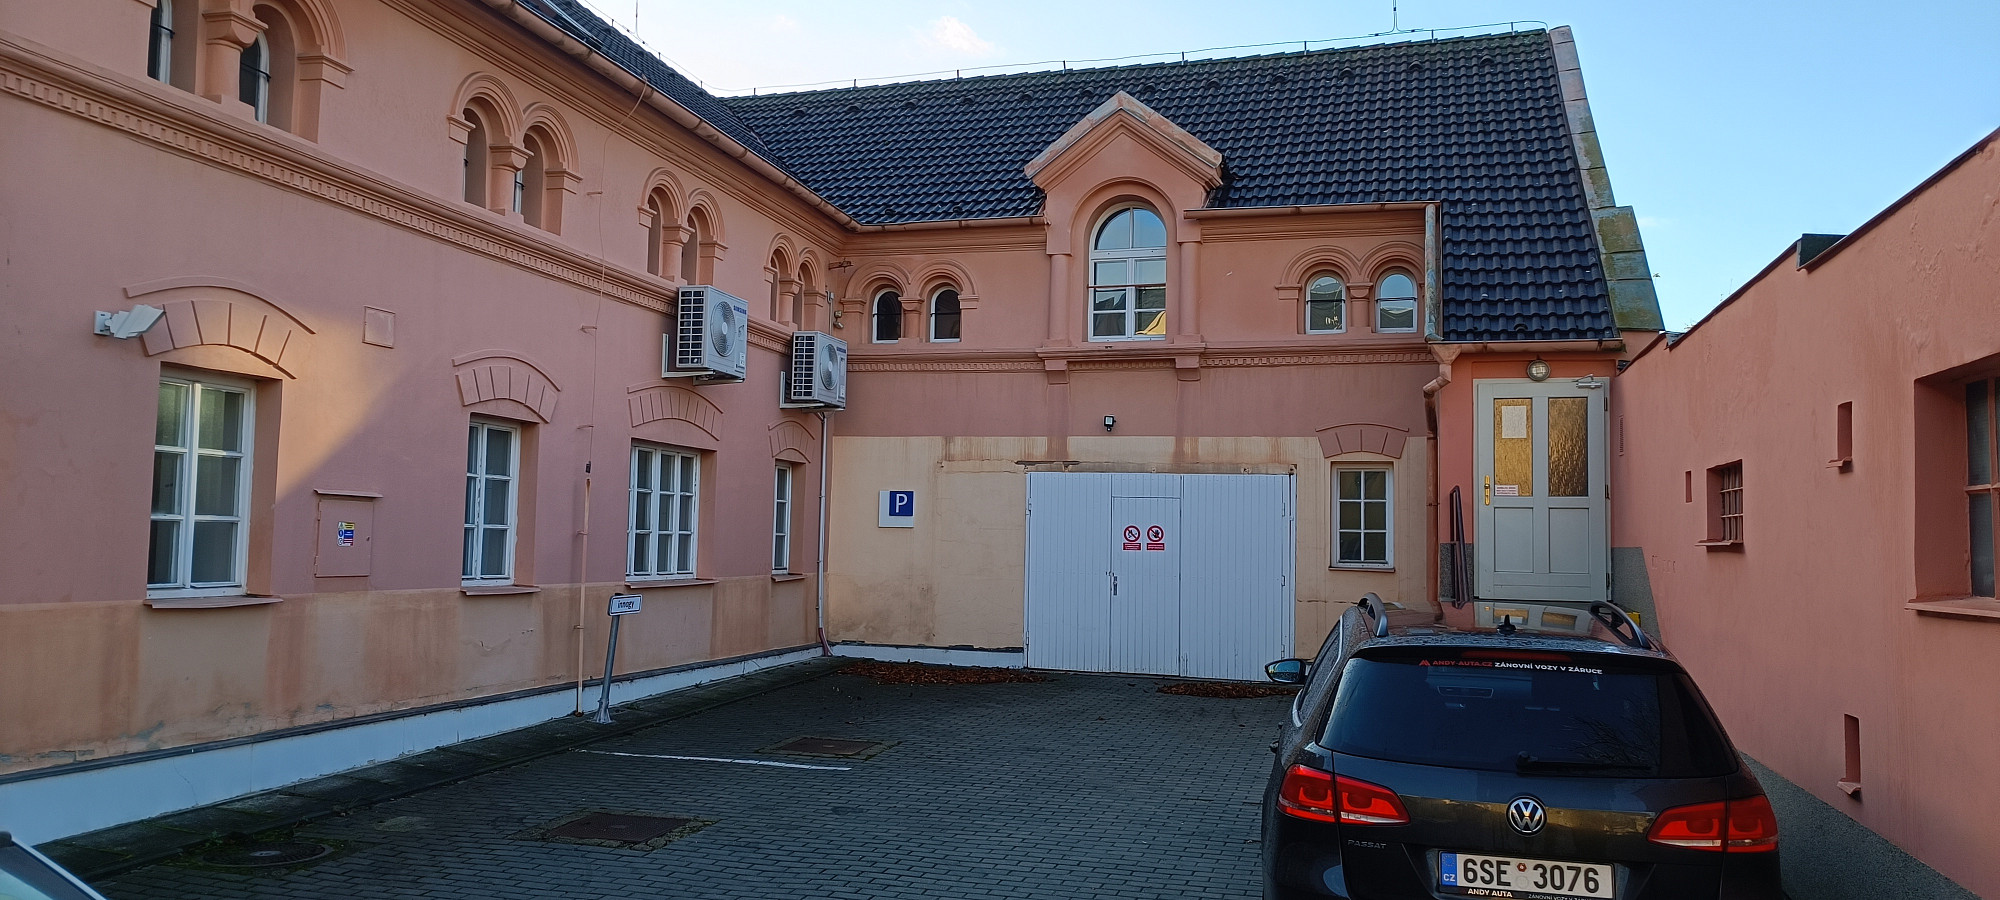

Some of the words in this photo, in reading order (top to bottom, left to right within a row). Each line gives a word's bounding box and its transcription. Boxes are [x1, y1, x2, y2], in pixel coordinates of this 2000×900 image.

[896, 493, 908, 513] P
[1495, 661, 1533, 670] ZÁNOVNÍ
[1568, 666, 1603, 675] ZÁRUCE
[1347, 839, 1387, 849] PASSAT
[1443, 873, 1456, 882] CZ
[1463, 858, 1511, 886] 6SE
[1532, 863, 1599, 893] 3076
[1467, 888, 1490, 896] ANDY
[1491, 890, 1513, 898] AUTA
